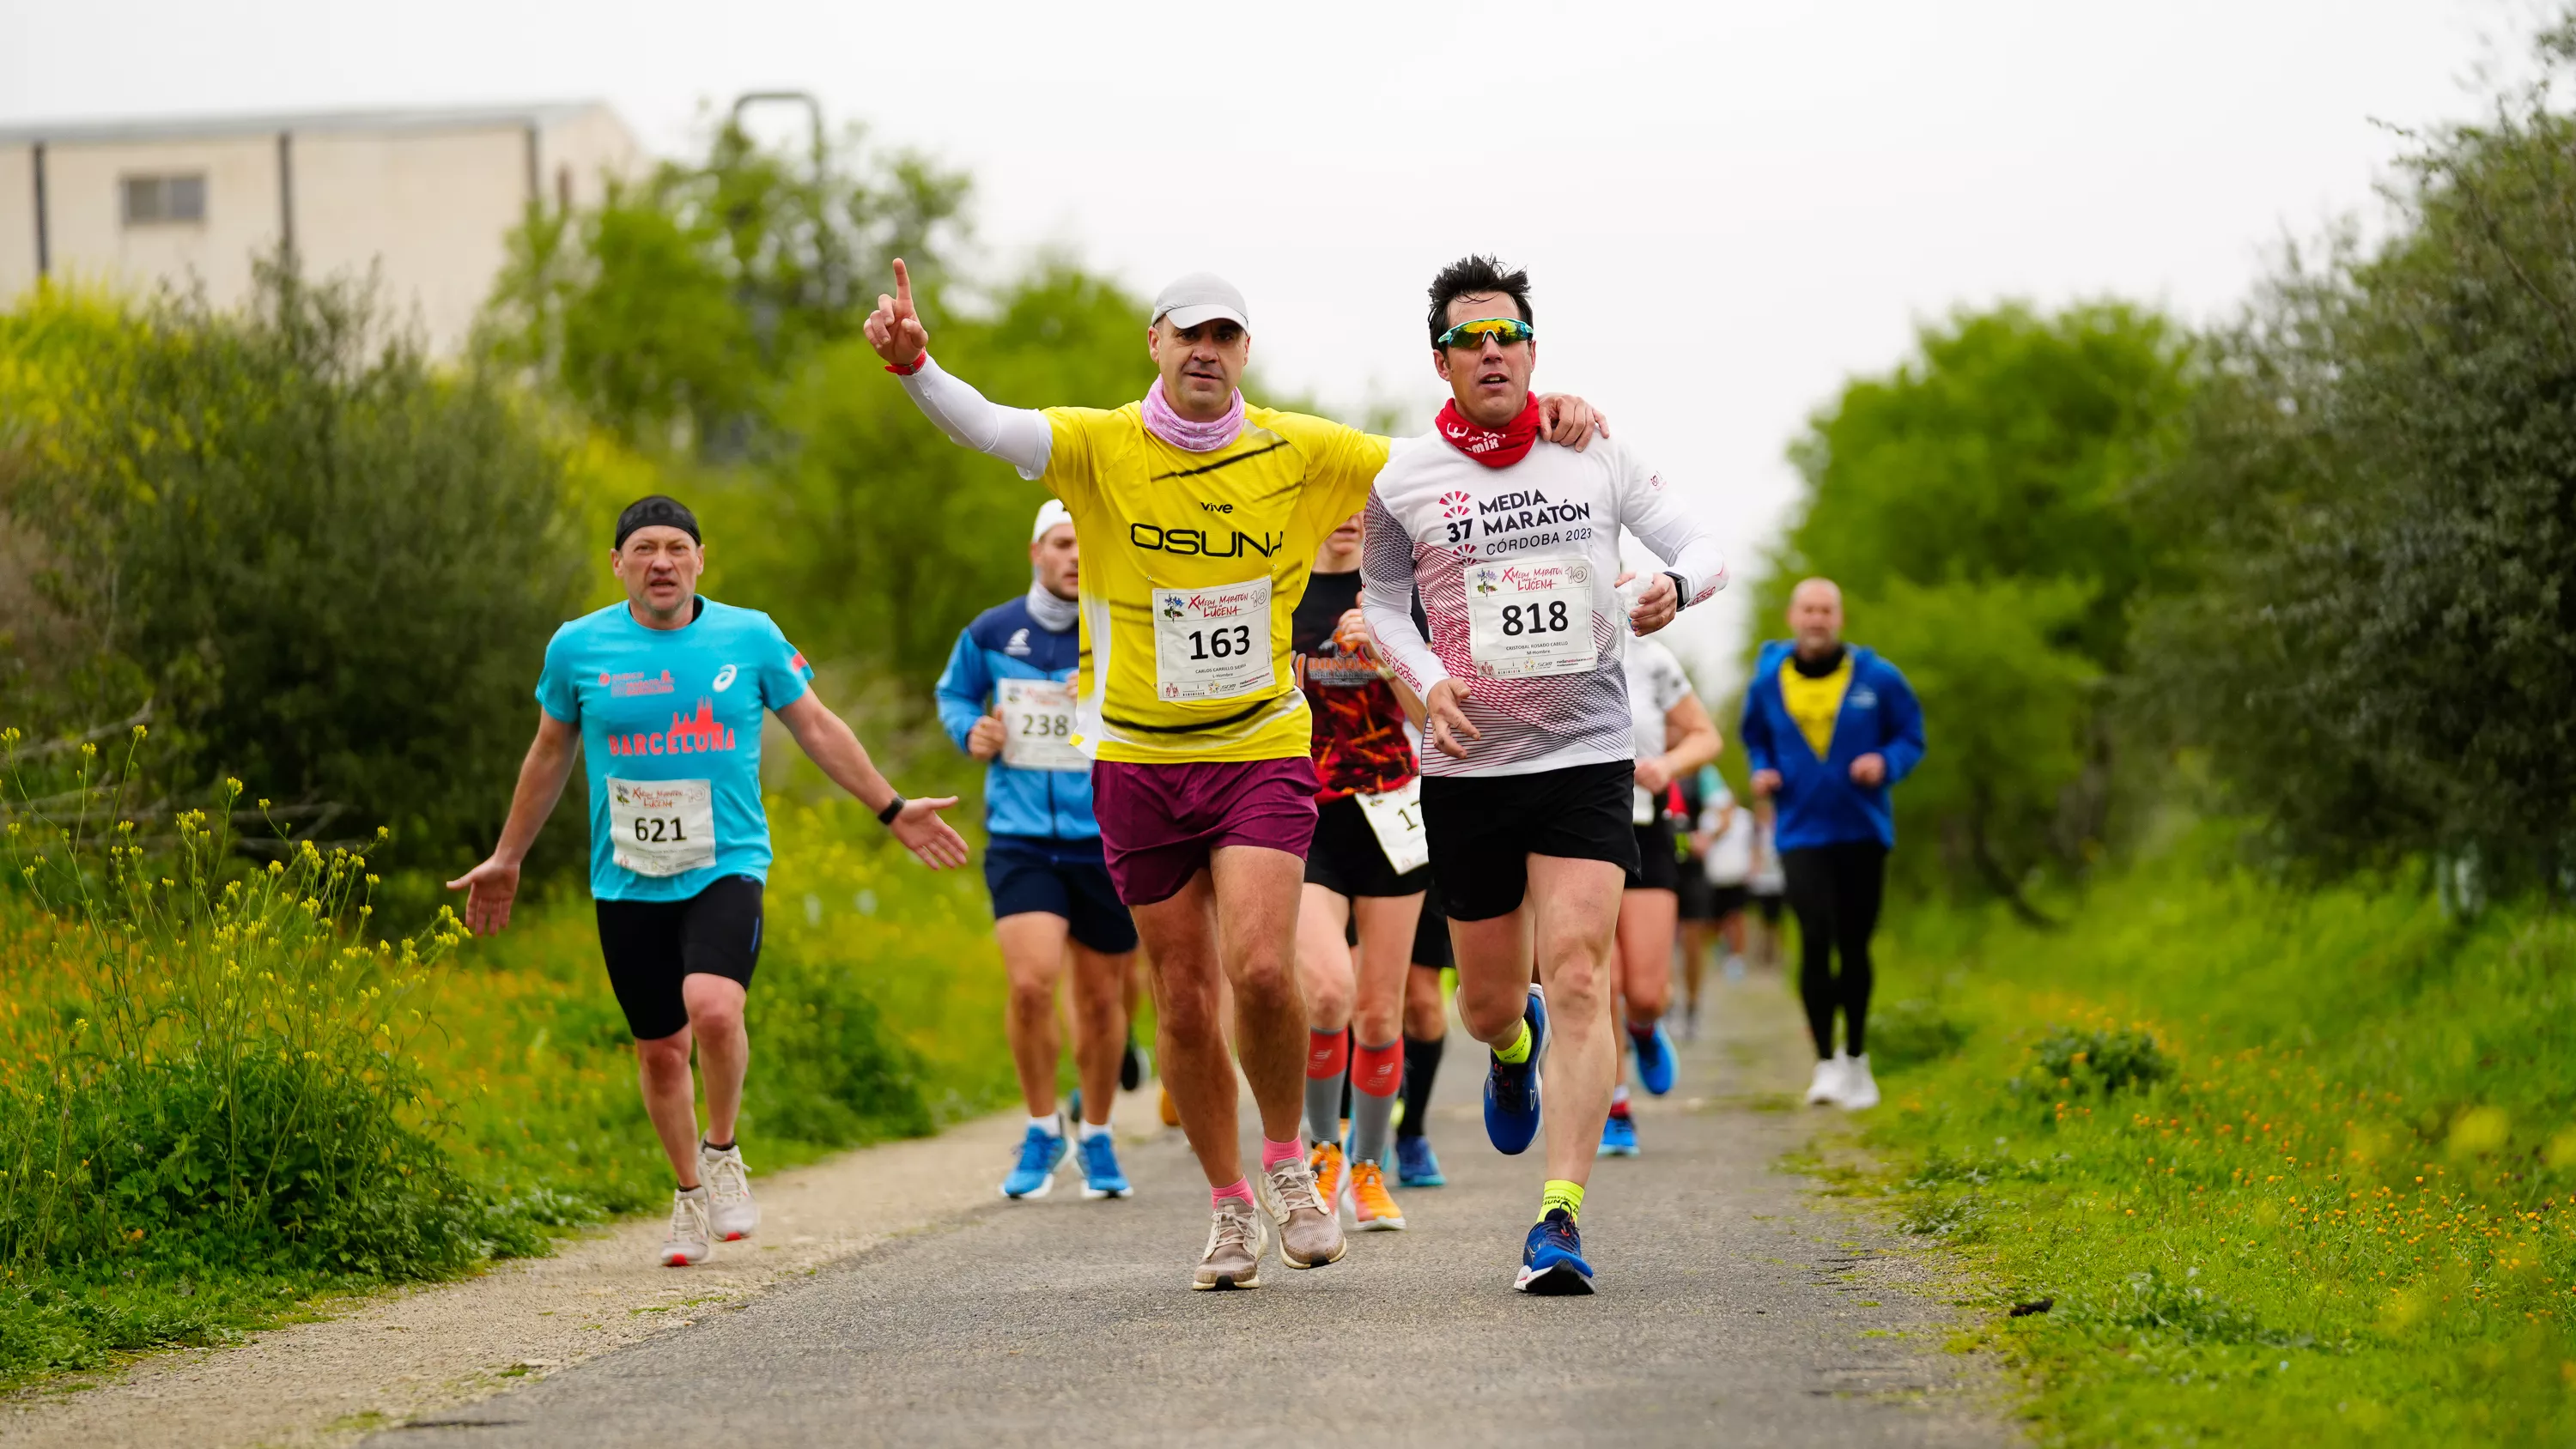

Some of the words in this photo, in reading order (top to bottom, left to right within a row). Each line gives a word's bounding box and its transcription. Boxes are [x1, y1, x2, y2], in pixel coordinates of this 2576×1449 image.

[1200, 502, 1233, 514] vive
[1479, 488, 1548, 516] MEDIA
[1446, 518, 1473, 543] 37
[1482, 499, 1590, 537] MARATÓN
[1486, 532, 1560, 556] CÓRDOBA
[1565, 528, 1592, 542] 2023
[1518, 579, 1558, 592] LUCENA
[1204, 605, 1242, 618] LUCENA
[1502, 600, 1569, 636] 818
[1188, 625, 1250, 660] 163
[1022, 713, 1069, 737] 238
[608, 728, 736, 756] BARCELONA
[635, 816, 687, 842] 621
